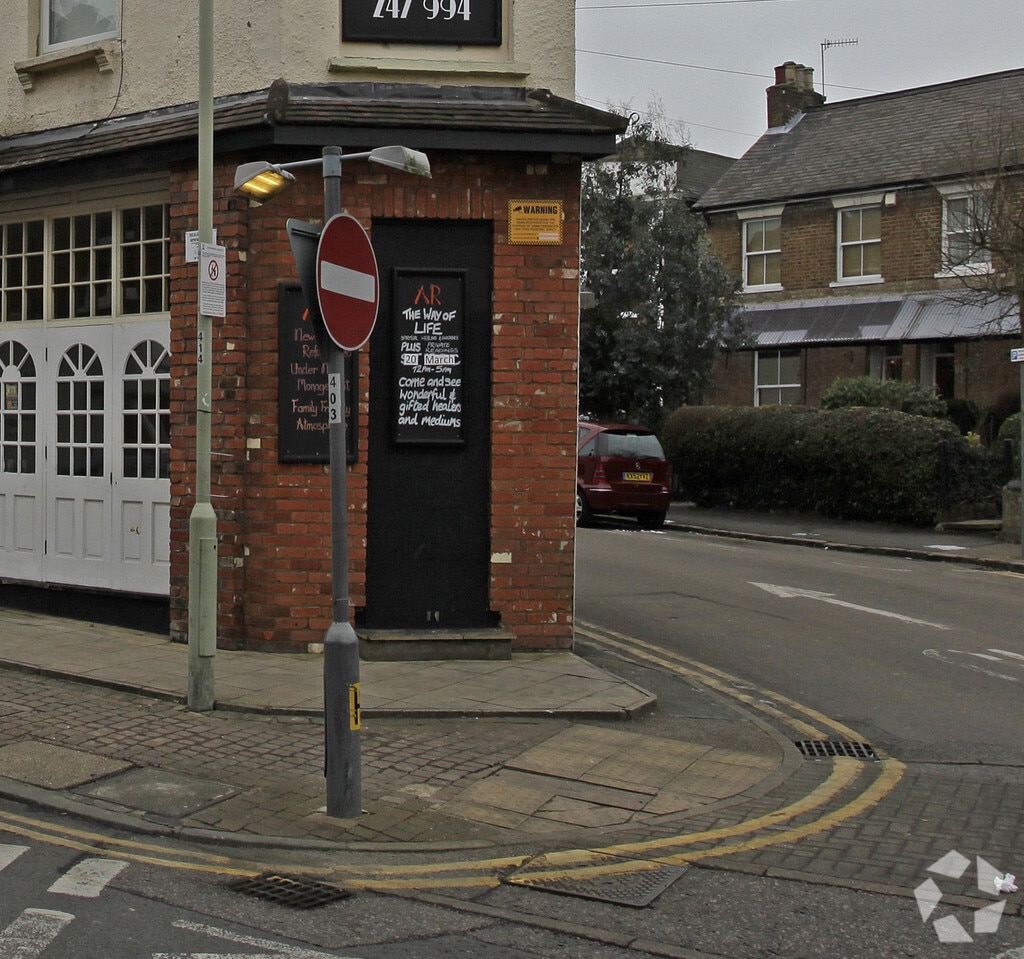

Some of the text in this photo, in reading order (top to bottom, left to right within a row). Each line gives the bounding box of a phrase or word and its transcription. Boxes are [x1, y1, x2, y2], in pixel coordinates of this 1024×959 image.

[523, 206, 558, 214] WARNING
[402, 307, 457, 322] THE WAY OF
[414, 321, 443, 335] LIFE
[400, 341, 422, 352] PLUS
[406, 354, 454, 364] 20 March
[290, 362, 318, 375] Under
[399, 375, 462, 387] Come and see
[291, 398, 318, 417] Family
[399, 400, 429, 416] gifted
[398, 413, 418, 425] and
